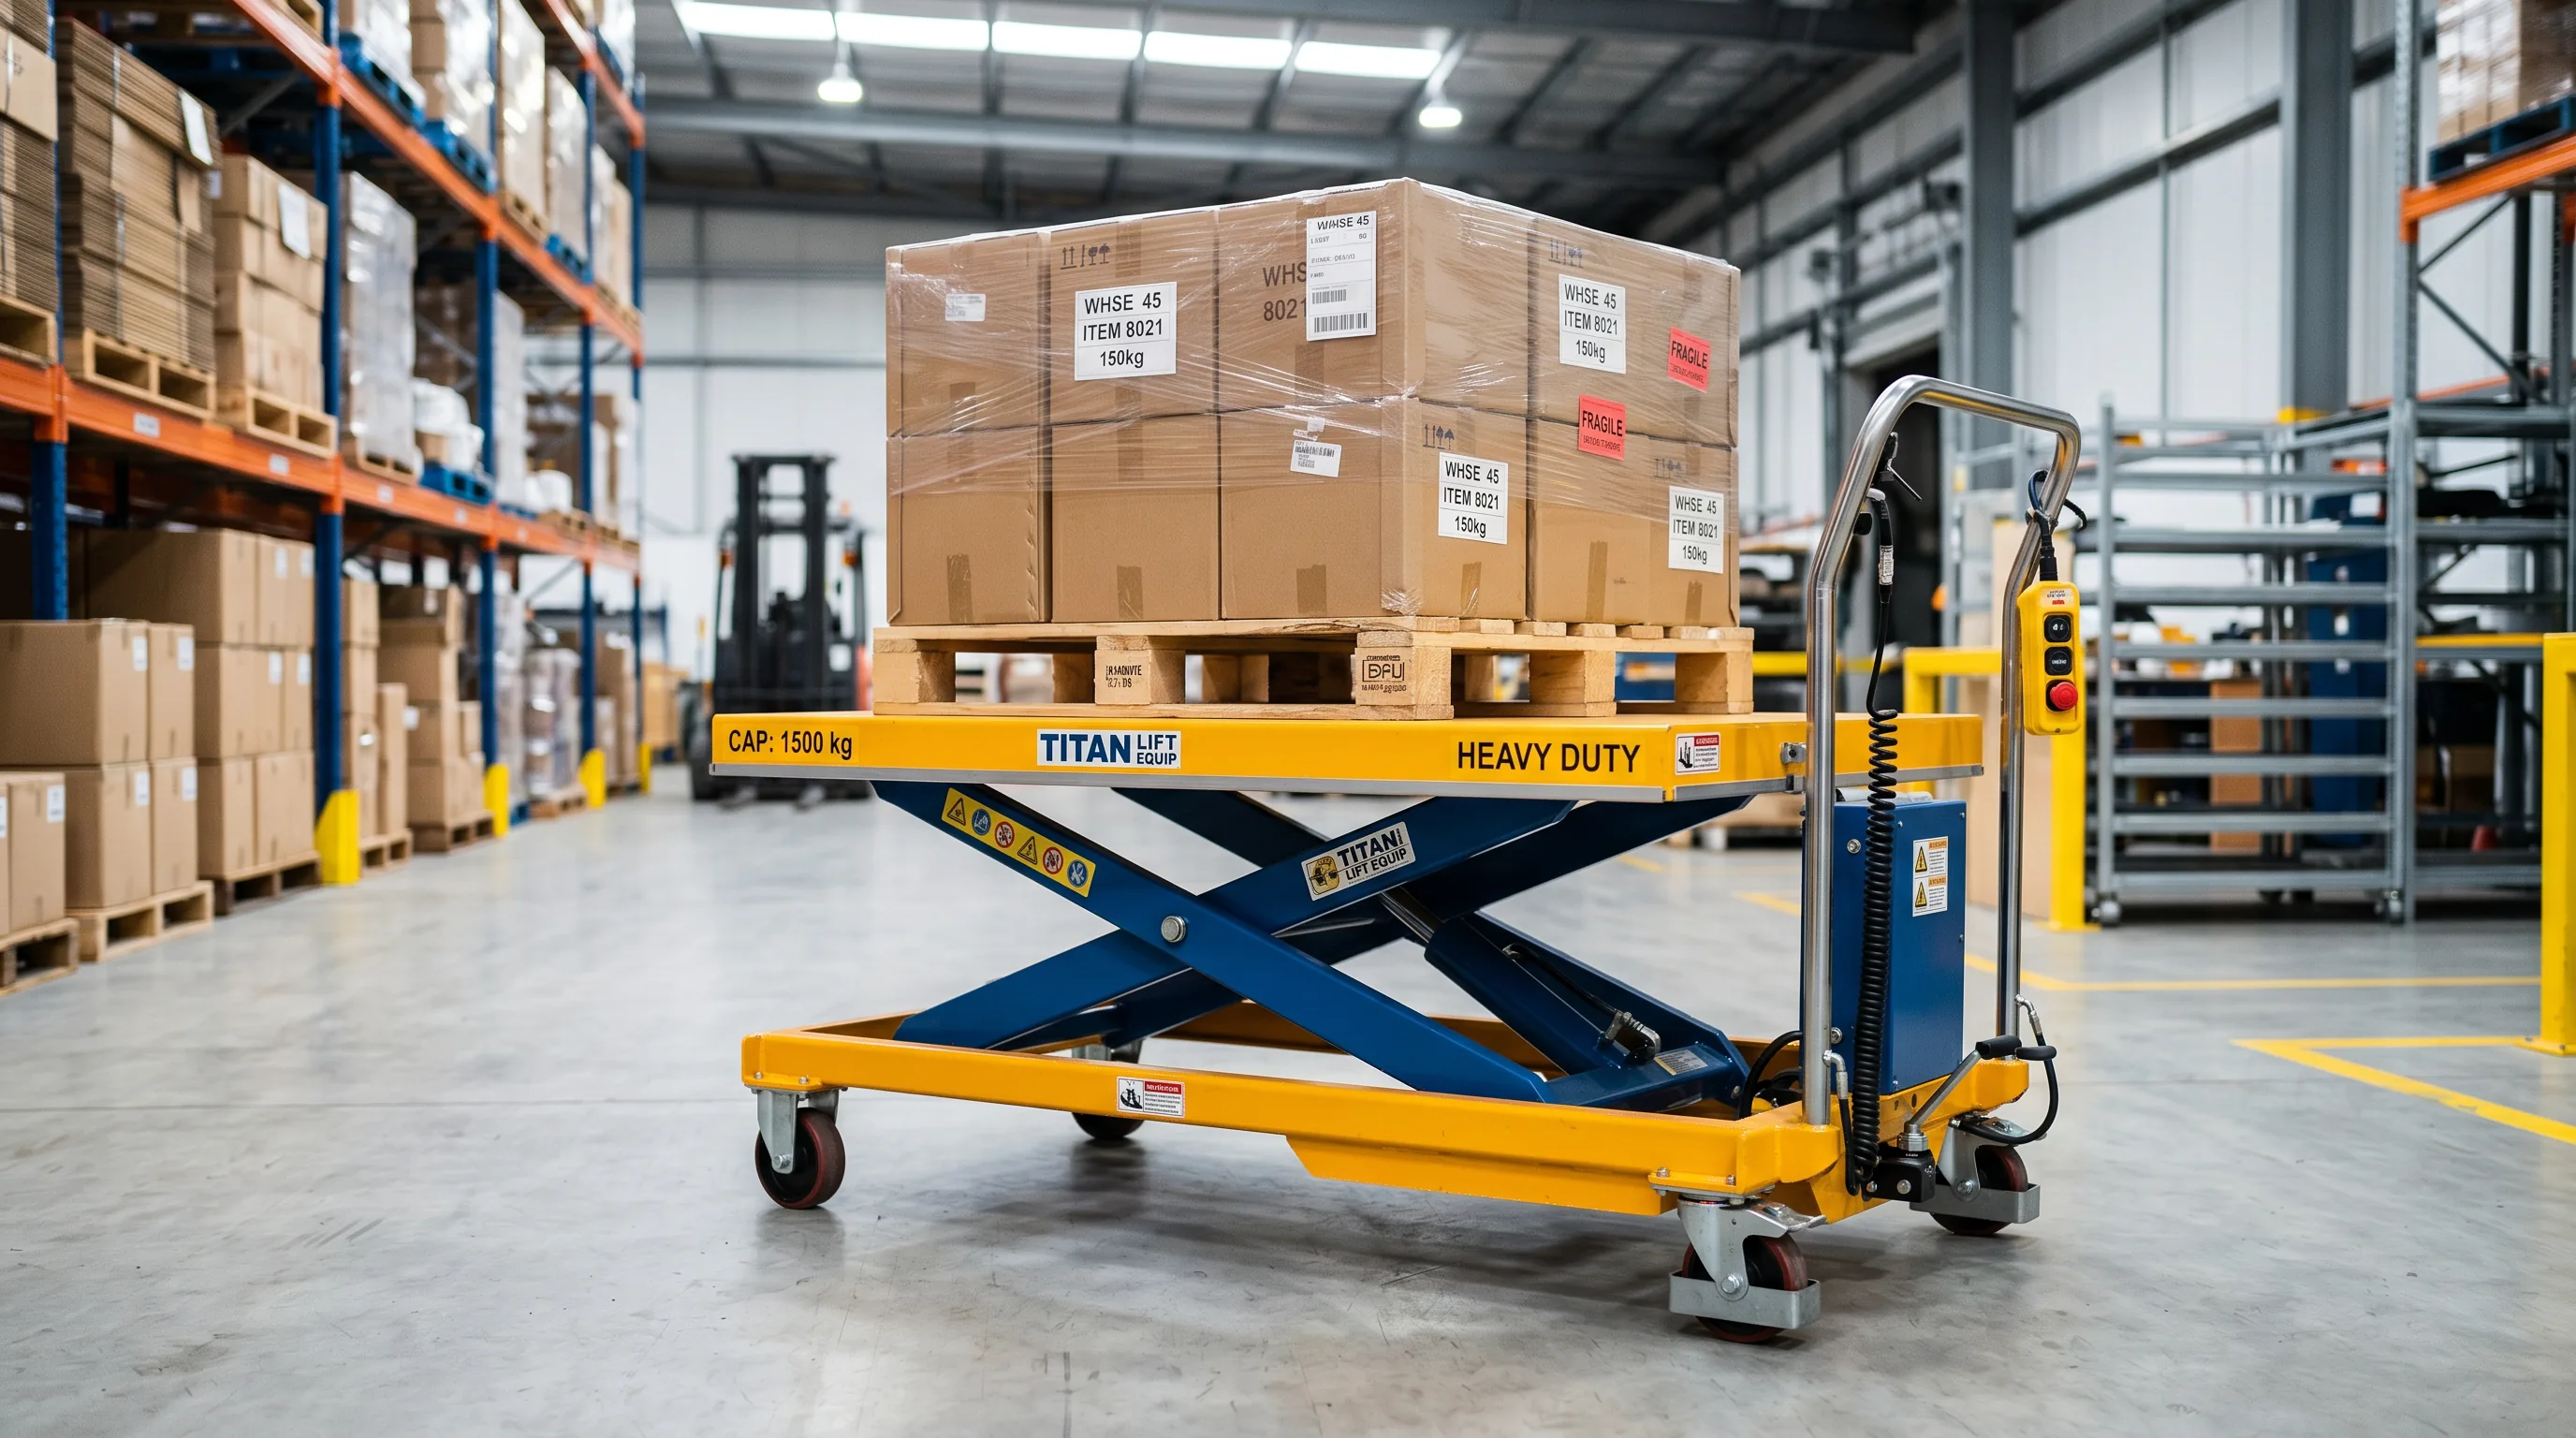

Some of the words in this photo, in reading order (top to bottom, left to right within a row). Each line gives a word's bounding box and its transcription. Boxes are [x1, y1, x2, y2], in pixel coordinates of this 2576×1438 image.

[1356, 214, 1369, 226] 45
[1084, 293, 1134, 315] WHSE
[1142, 291, 1162, 310] 45
[1264, 296, 1307, 322] 8021
[1564, 283, 1599, 306] WHSE
[1603, 292, 1617, 310] 45
[1083, 321, 1120, 342] ITEM
[1126, 318, 1162, 338] 8021
[1564, 309, 1591, 330] ITEM
[1594, 315, 1617, 335] 8021
[1100, 348, 1144, 369] 150kg
[1575, 339, 1605, 364] 150kg
[1671, 340, 1708, 370] FRAGILE
[1582, 409, 1623, 437] FRAGILE
[1444, 460, 1481, 482] WHSE
[1486, 468, 1500, 485] 45
[1443, 486, 1471, 506] ITEM
[1474, 492, 1499, 510] 8021
[1675, 494, 1703, 513] WHSE
[1706, 500, 1717, 515] 45
[1455, 515, 1486, 538] 150kg
[1673, 519, 1695, 536] ITEM
[1698, 521, 1718, 539] 8021
[1682, 544, 1707, 565] 150kg
[728, 728, 773, 754] CAP:
[781, 729, 824, 755] 1500
[829, 730, 853, 761] kg
[1040, 733, 1131, 764] TITAN
[1136, 734, 1178, 751] LIFT
[1136, 752, 1178, 766] EQUIP
[1457, 741, 1552, 771] HEAVY
[1561, 742, 1641, 773] DUTY
[1336, 829, 1399, 867] TITAN
[1345, 862, 1368, 881] LIFT
[1371, 847, 1407, 872] EQUIP
